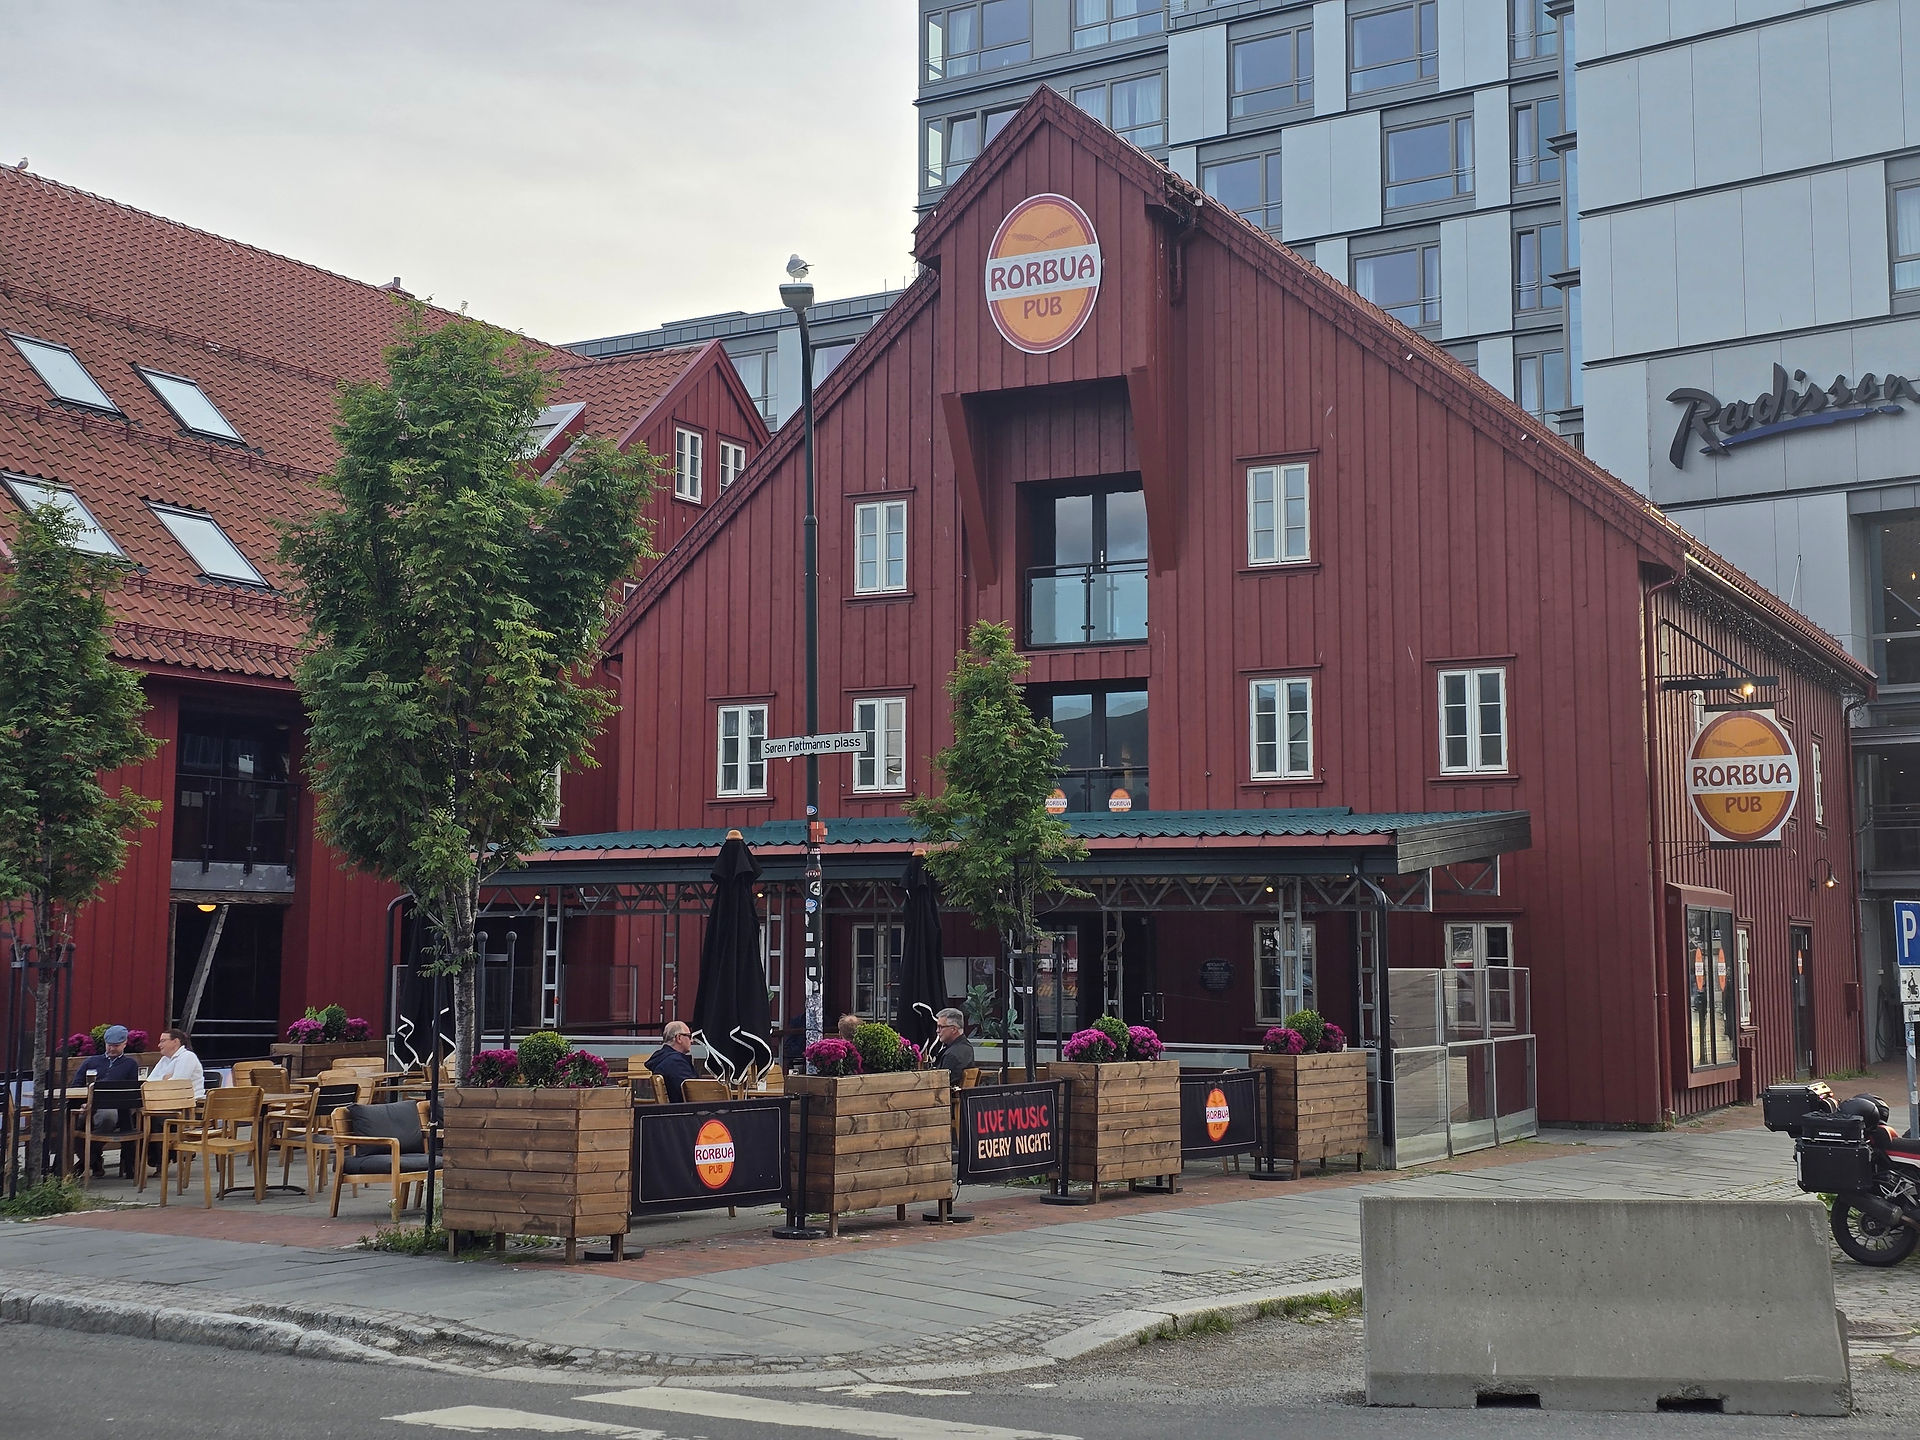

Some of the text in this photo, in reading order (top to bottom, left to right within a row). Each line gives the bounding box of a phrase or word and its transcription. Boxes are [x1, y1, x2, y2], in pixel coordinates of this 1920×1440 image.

[991, 254, 1095, 291] RORBUA
[1024, 296, 1063, 319] PUB
[1666, 362, 1920, 469] Radisson
[765, 737, 861, 754] Søren Fløttmanns plass
[1692, 763, 1792, 787] RORBUA
[1725, 796, 1762, 813] PUB
[1902, 910, 1917, 958] P
[977, 1105, 1049, 1133] LIVE MUSIC
[696, 1147, 734, 1161] RORBUA
[978, 1132, 1051, 1159] EVERY NIGHT!
[708, 1165, 723, 1174] PUB
